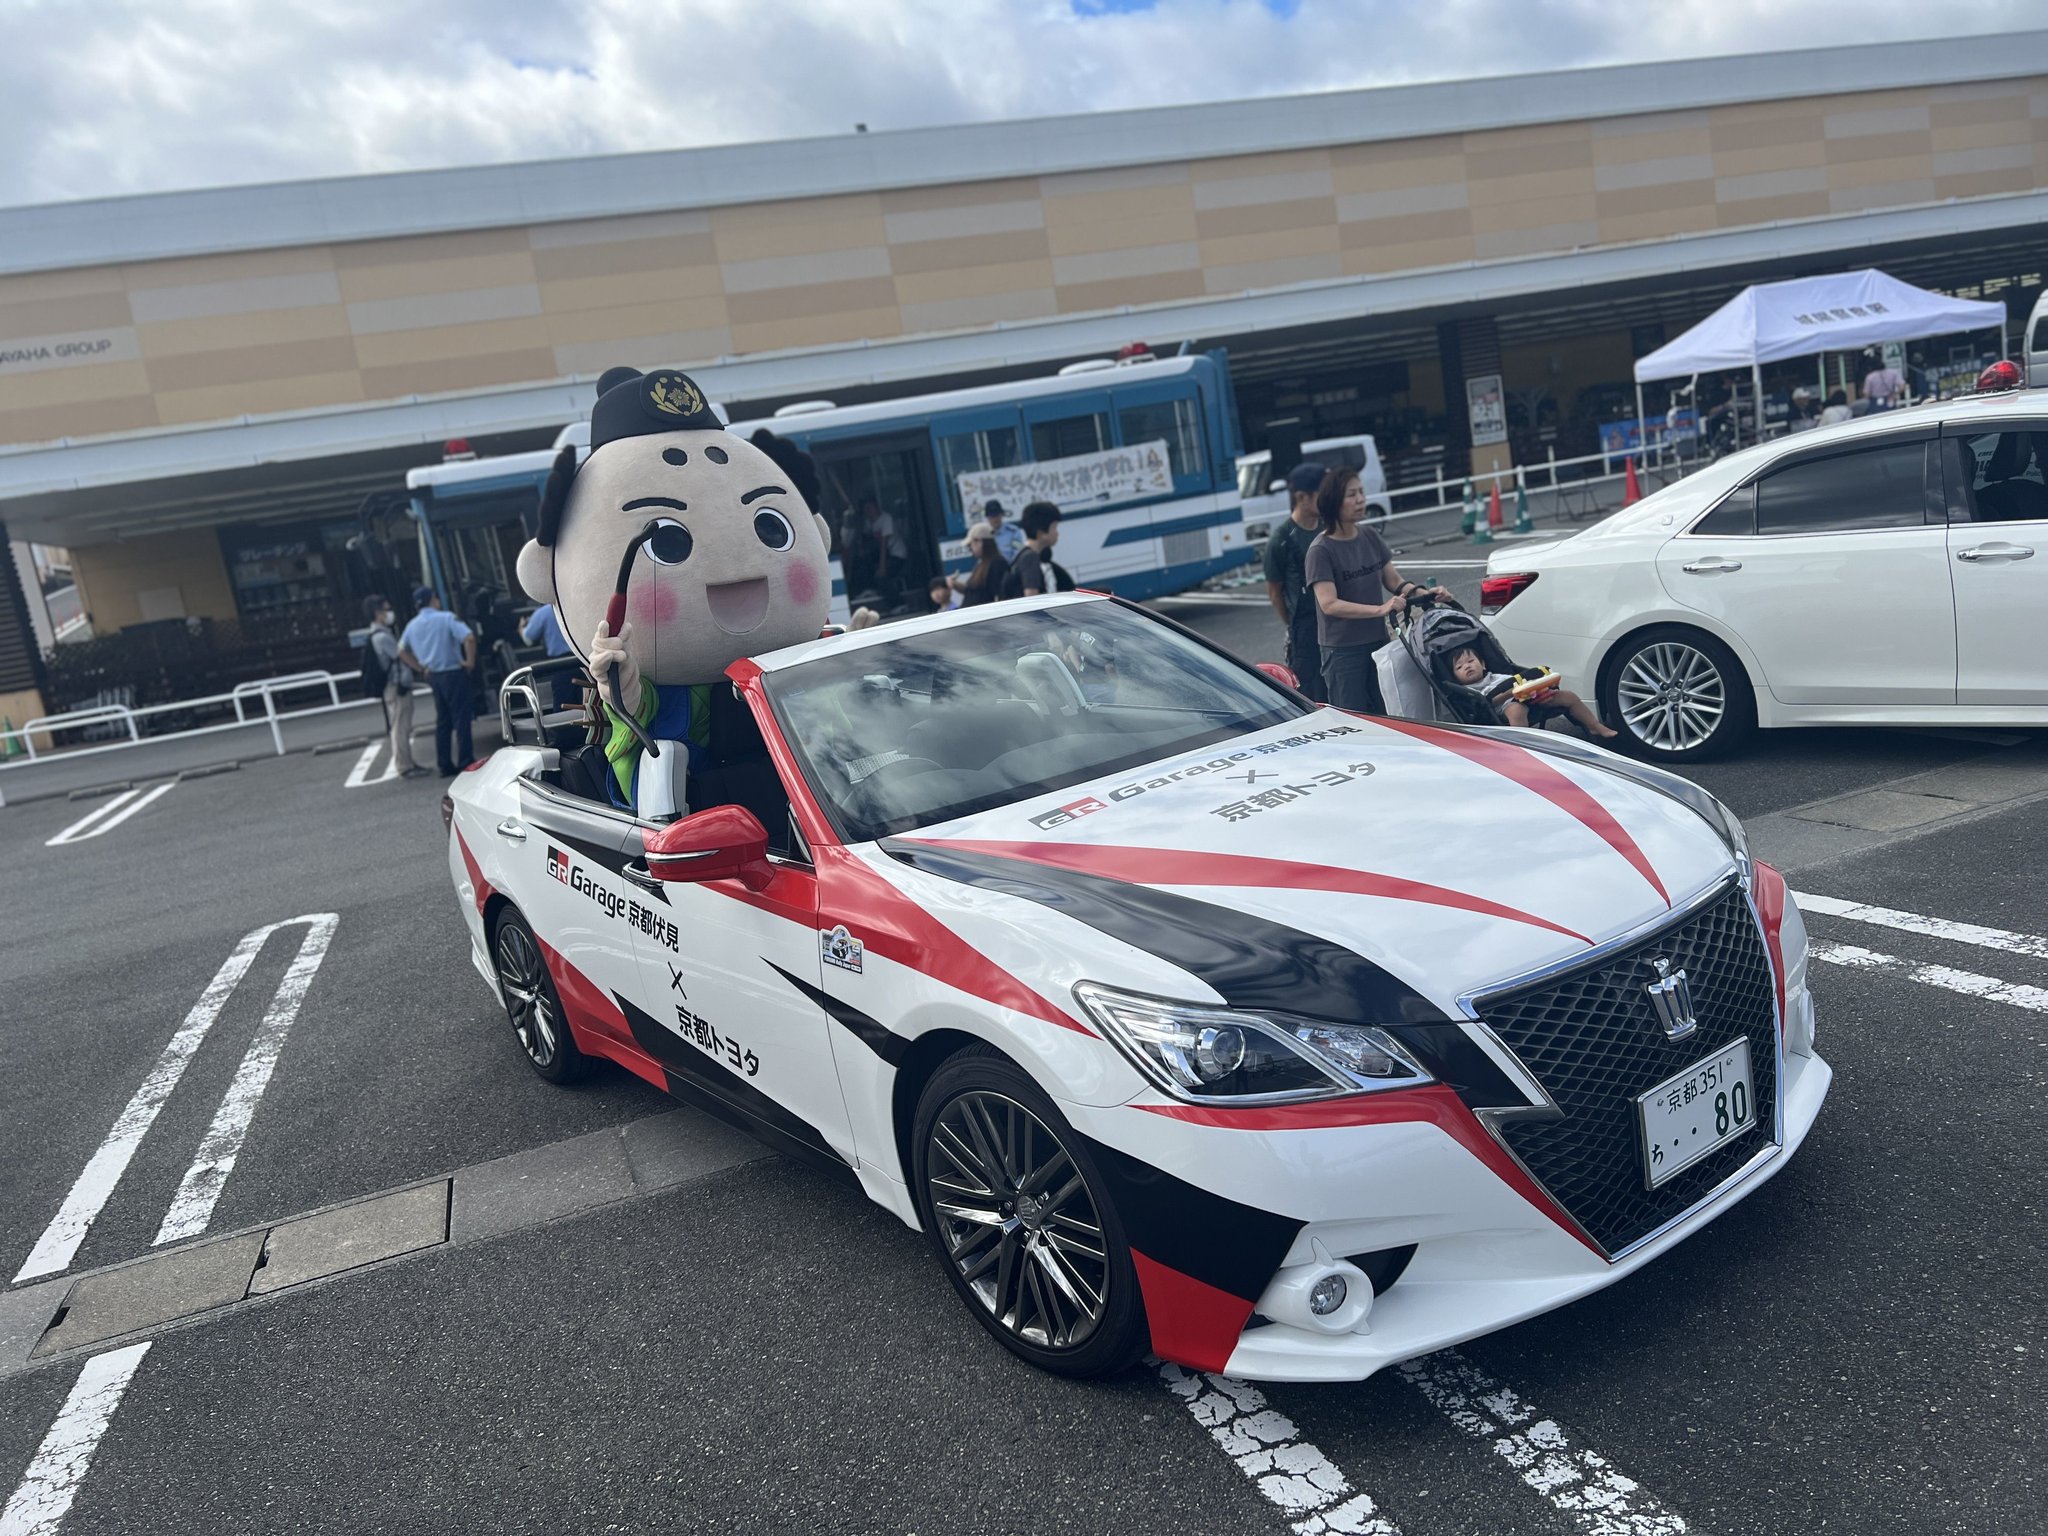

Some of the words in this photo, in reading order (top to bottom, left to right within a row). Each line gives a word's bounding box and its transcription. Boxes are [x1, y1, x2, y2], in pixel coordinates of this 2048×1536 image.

[55, 339, 112, 358] GROUP
[1033, 798, 1108, 831] GR
[1108, 752, 1254, 803] Garage
[1251, 726, 1363, 754] 京都伏見
[1209, 762, 1376, 822] 京都トヨタ
[546, 851, 569, 885] GR
[570, 865, 626, 919] Garage
[627, 899, 679, 953] 京都伏見
[675, 1004, 760, 1077] 京都トヨタ
[1651, 1143, 1664, 1166] ち
